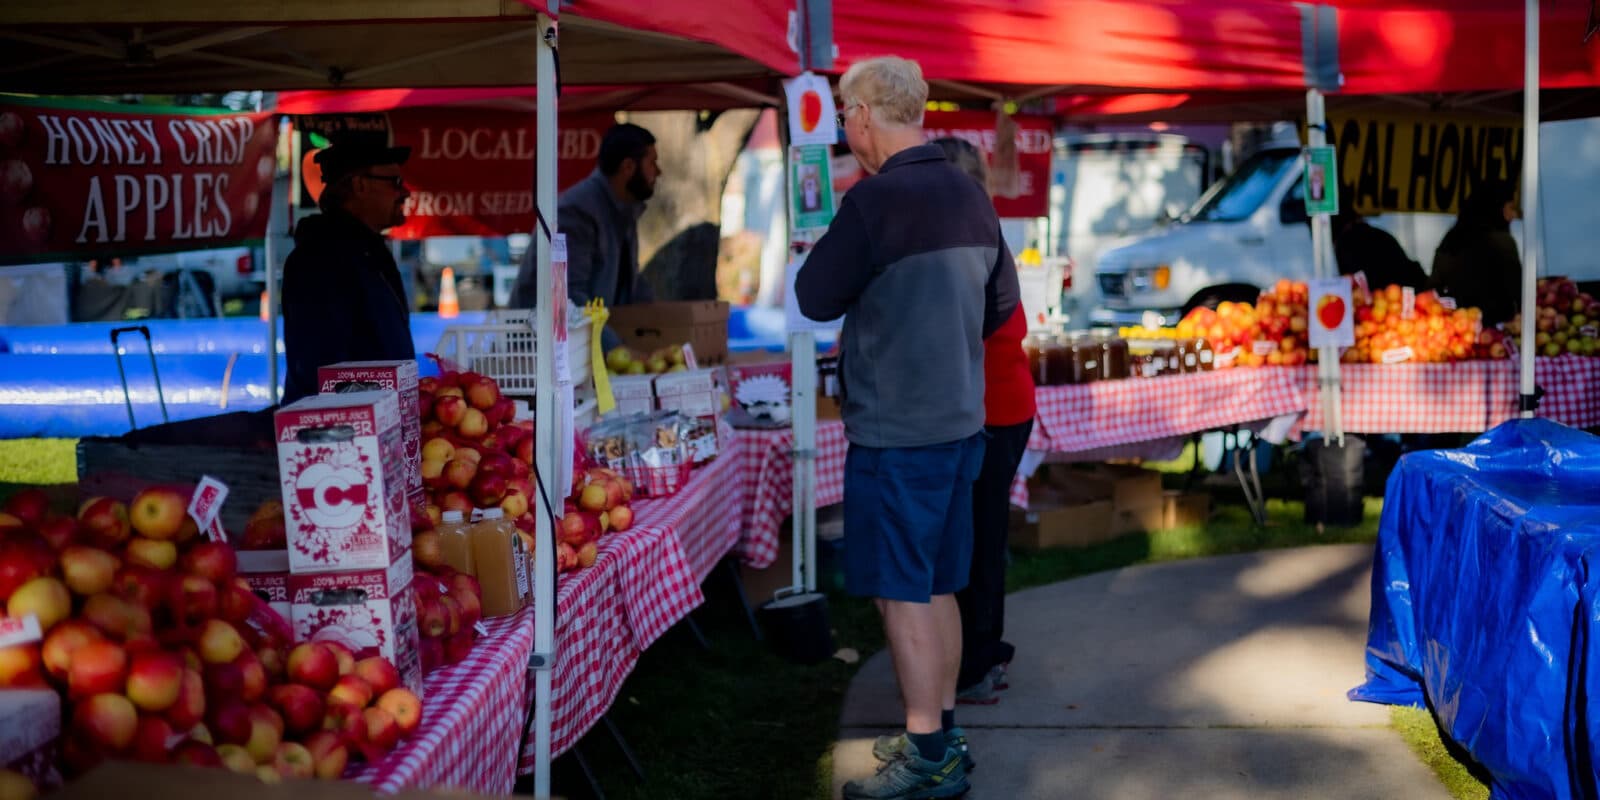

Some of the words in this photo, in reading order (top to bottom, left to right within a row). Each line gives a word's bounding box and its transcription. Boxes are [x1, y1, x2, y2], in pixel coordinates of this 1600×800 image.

[38, 115, 162, 166] HONEY
[168, 116, 254, 166] CRISP
[420, 127, 536, 160] LOCAL
[557, 128, 602, 160] BD
[1410, 120, 1524, 209] HONEY
[75, 173, 232, 244] APPLES
[402, 191, 475, 217] FROM
[480, 190, 534, 215] SEED
